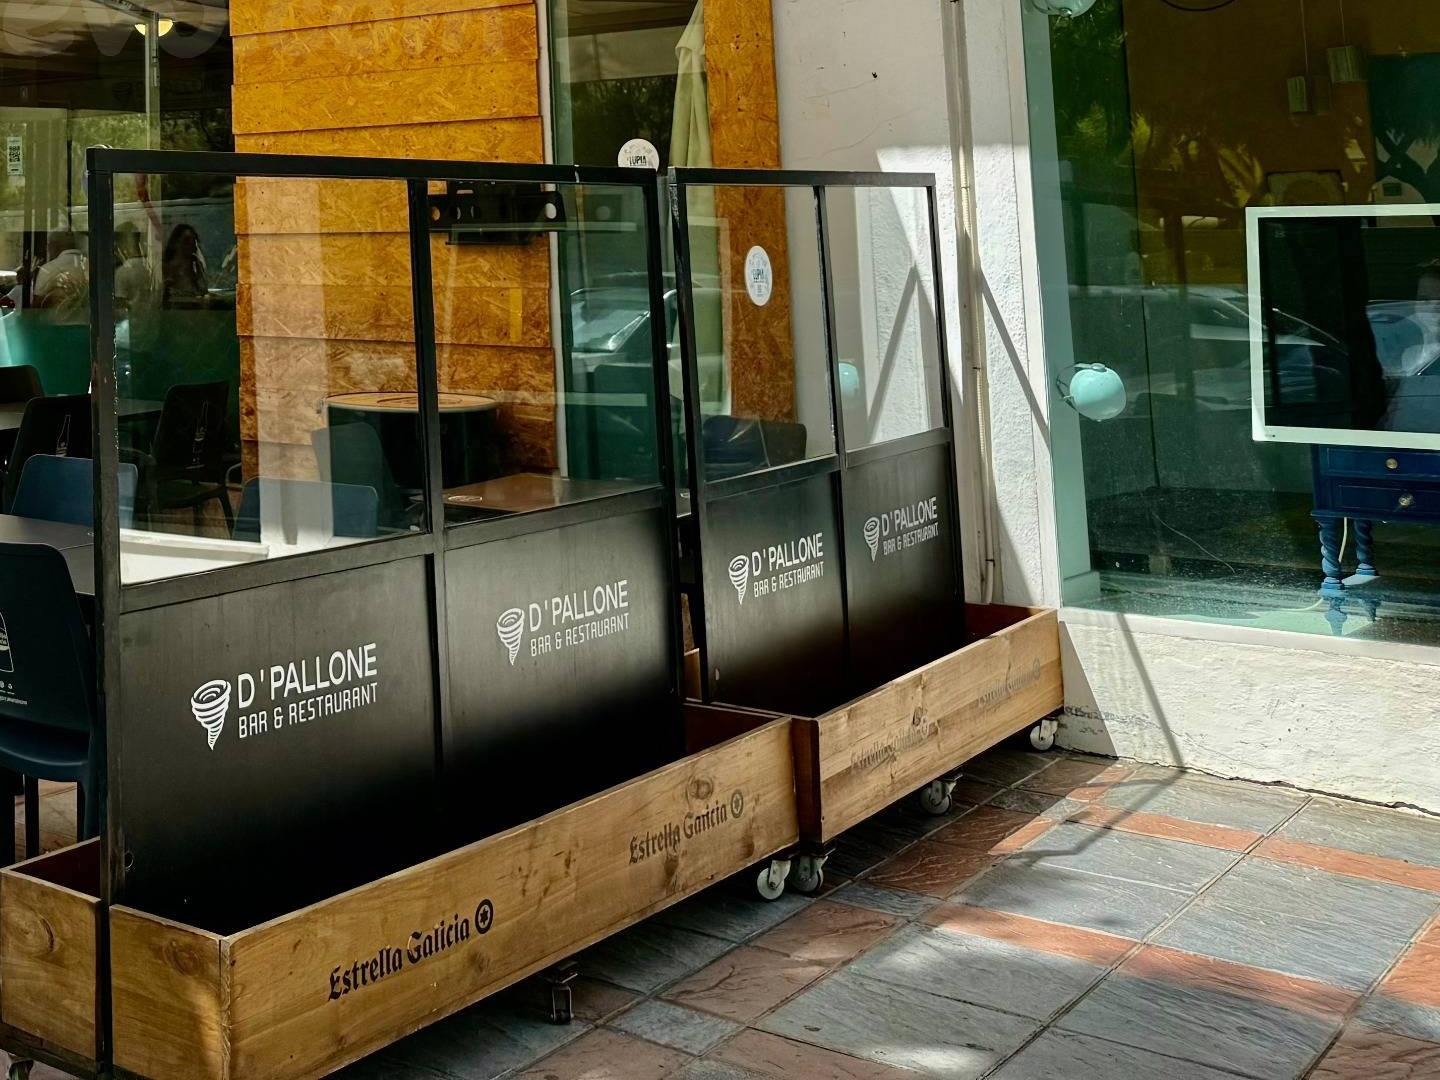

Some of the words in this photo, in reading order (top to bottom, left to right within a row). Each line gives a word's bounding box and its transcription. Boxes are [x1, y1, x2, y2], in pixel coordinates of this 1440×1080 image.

[882, 538, 896, 555] BAR
[897, 536, 902, 551] &
[903, 522, 939, 549] RESTAURANT
[753, 579, 769, 598] BAR
[771, 576, 777, 592] &
[779, 561, 824, 589] RESTAURANT
[530, 635, 552, 657] BAR
[555, 631, 563, 650] &
[566, 612, 629, 646] RESTAURANT
[238, 711, 268, 739] BAR
[273, 707, 284, 729] &
[289, 682, 378, 725] RESTAURANT
[629, 822, 681, 865] Estrella
[327, 945, 403, 1001] Estrella
[407, 913, 470, 964] Galicia
